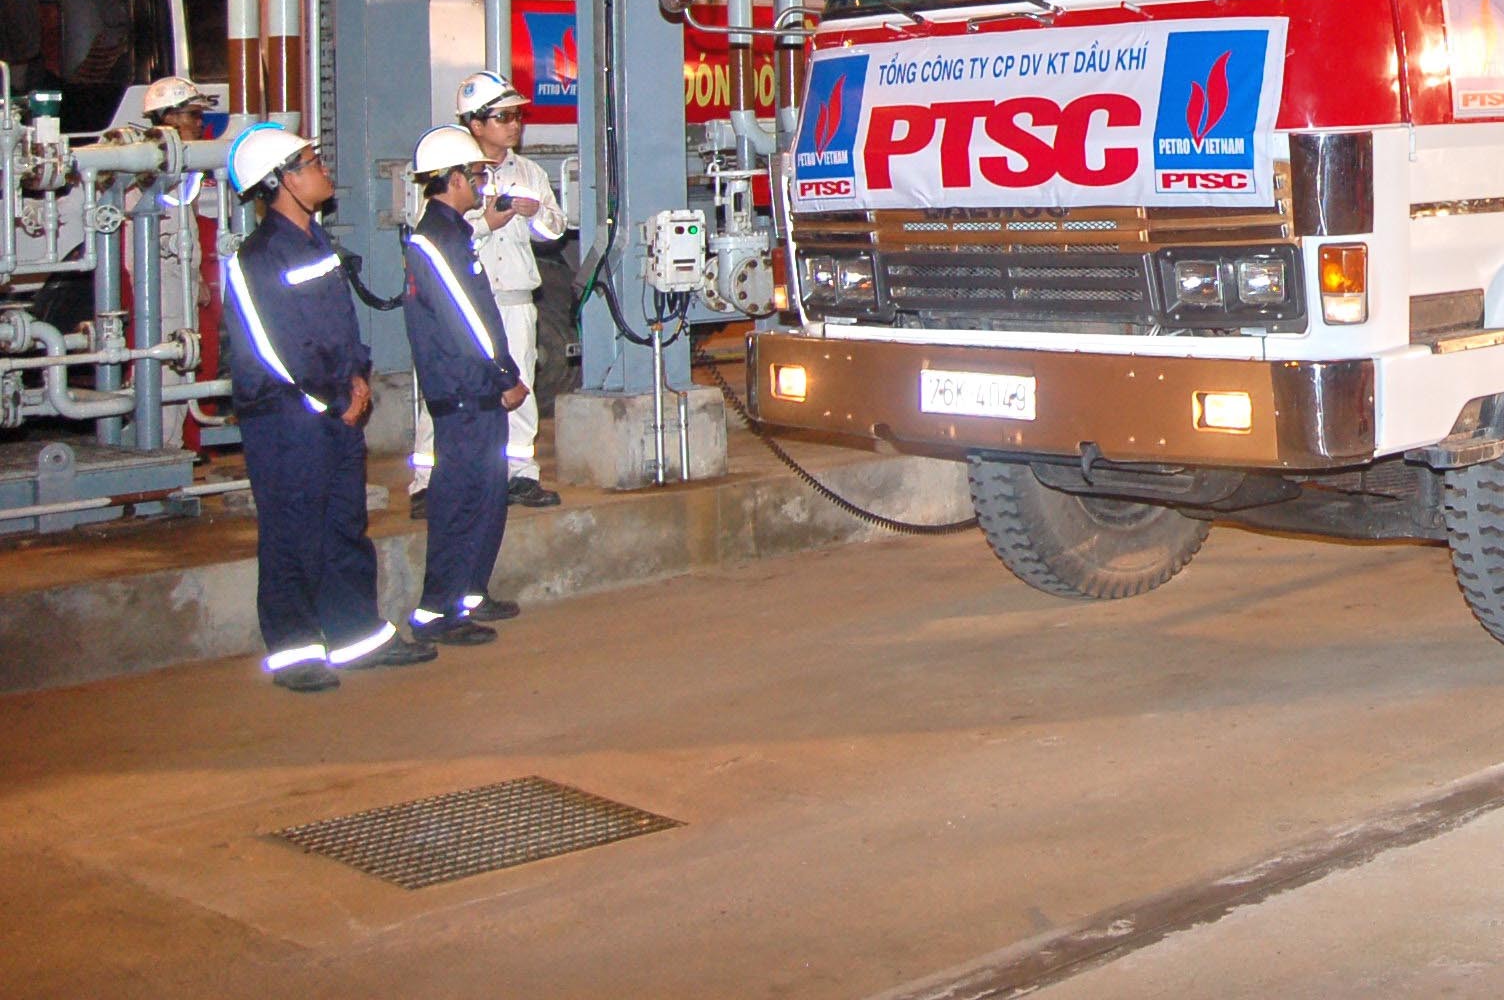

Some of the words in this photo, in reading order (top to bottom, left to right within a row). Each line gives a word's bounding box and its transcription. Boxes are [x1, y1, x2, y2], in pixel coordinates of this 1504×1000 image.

[879, 52, 917, 86] TỔNG
[921, 55, 963, 82] CÔNG
[970, 57, 989, 79] TY
[993, 55, 1014, 77] CP
[1020, 54, 1043, 76] DV
[1047, 52, 1069, 75] KT
[1074, 40, 1110, 73] DẦU
[1115, 40, 1149, 71] KHÍ
[864, 94, 1141, 190] PTSC
[800, 180, 850, 197] PTSC
[1162, 172, 1247, 189] PTSC
